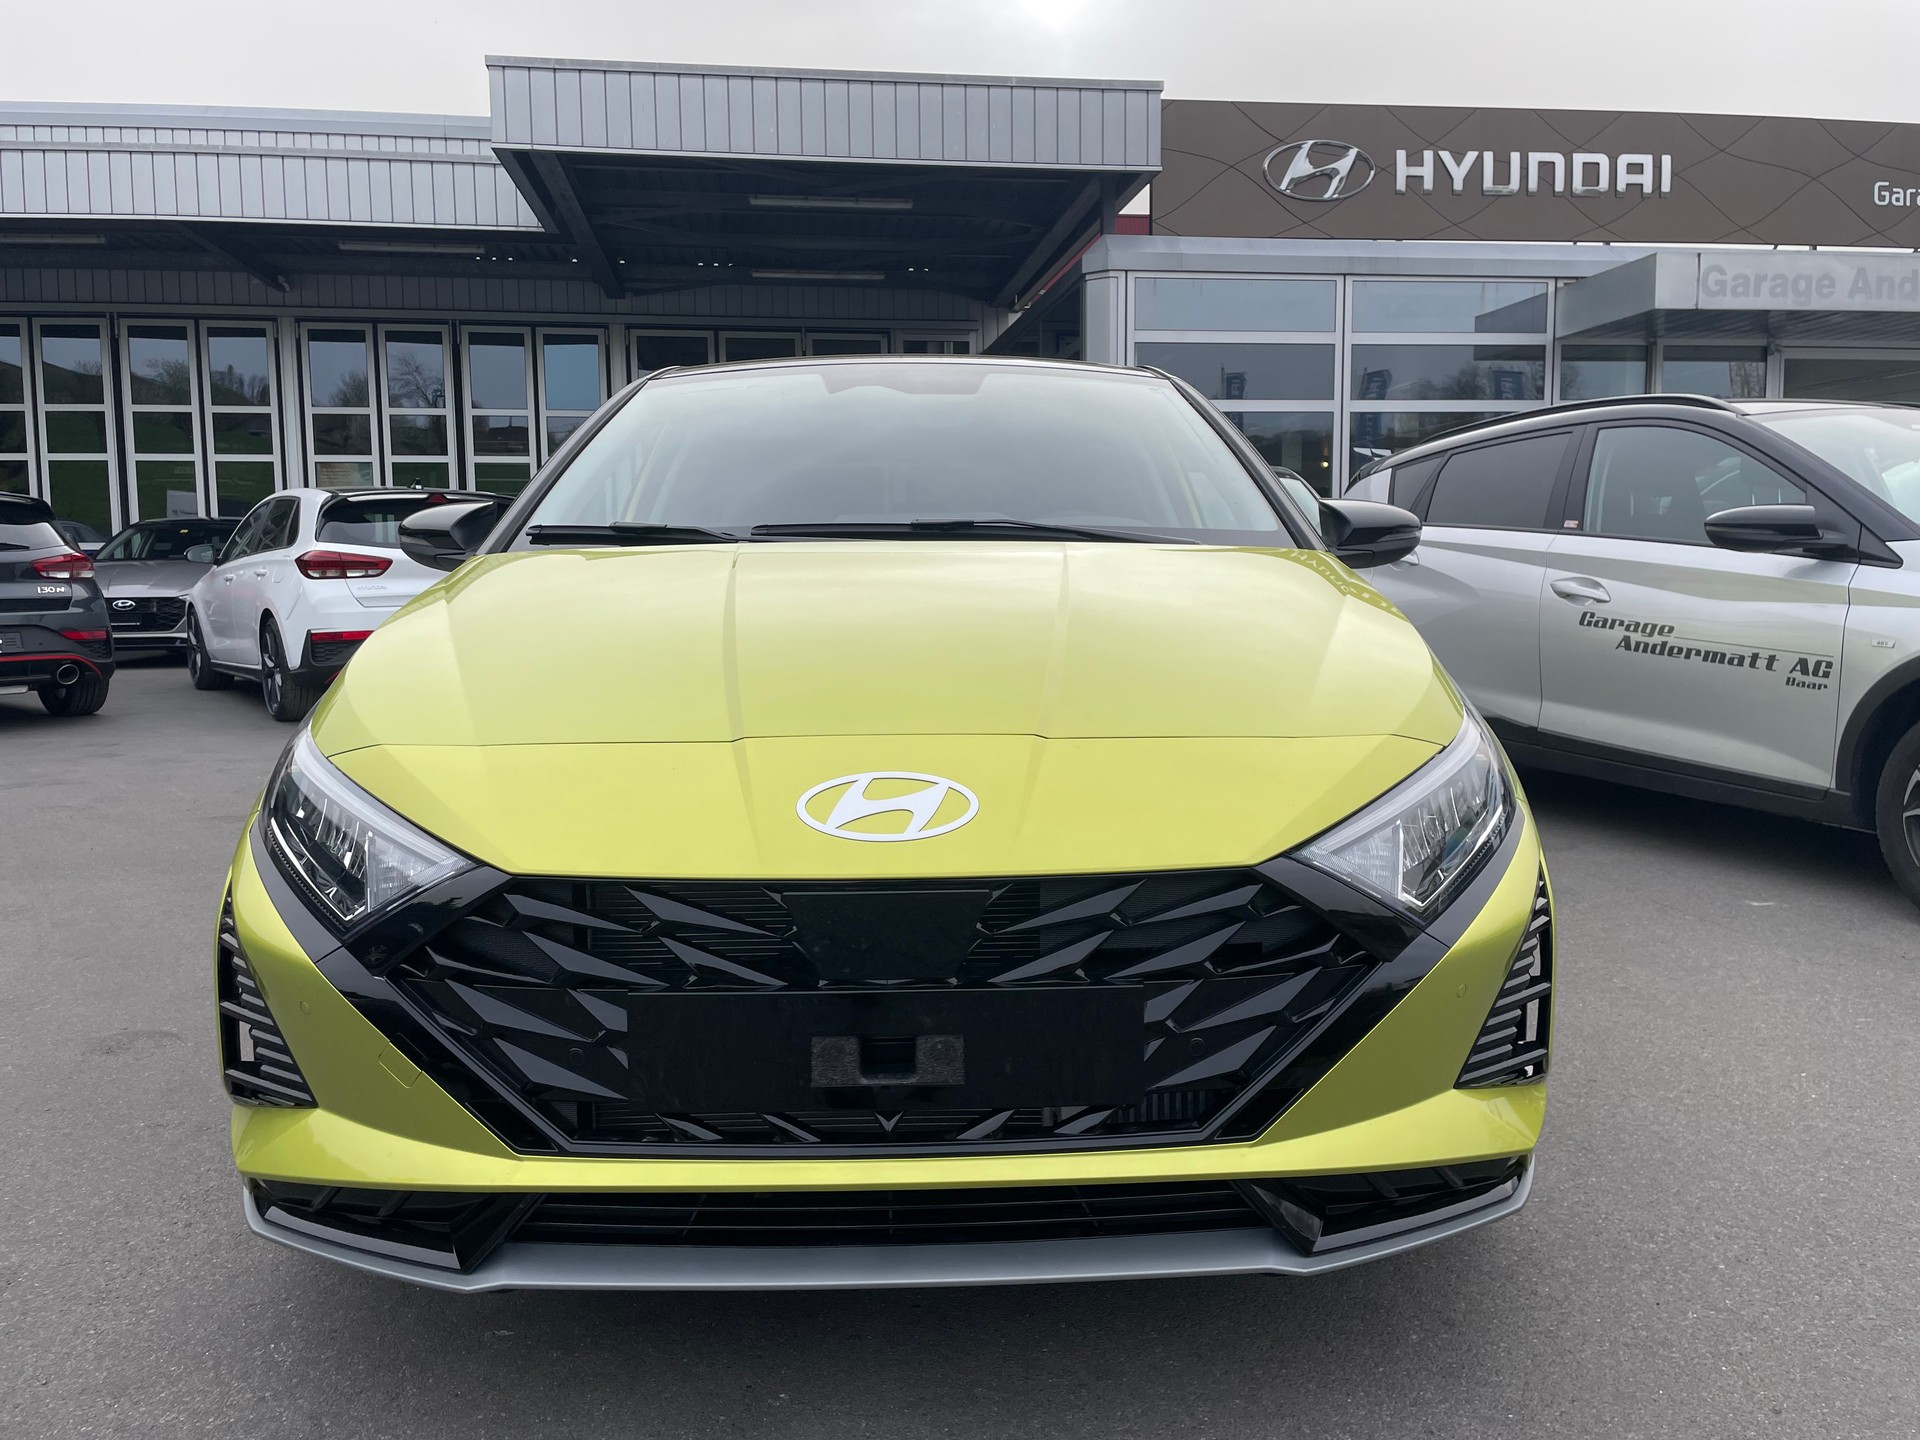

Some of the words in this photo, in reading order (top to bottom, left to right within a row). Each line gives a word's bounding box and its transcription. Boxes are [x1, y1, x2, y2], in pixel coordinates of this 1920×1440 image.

[1395, 149, 1672, 196] HYUNDAI
[1701, 264, 1836, 306] Garage
[1848, 268, 1920, 300] And
[1579, 611, 1674, 637] Garage
[1615, 636, 1779, 671] Andermatt
[1788, 658, 1834, 679] AG
[1785, 678, 1828, 691] Baar
